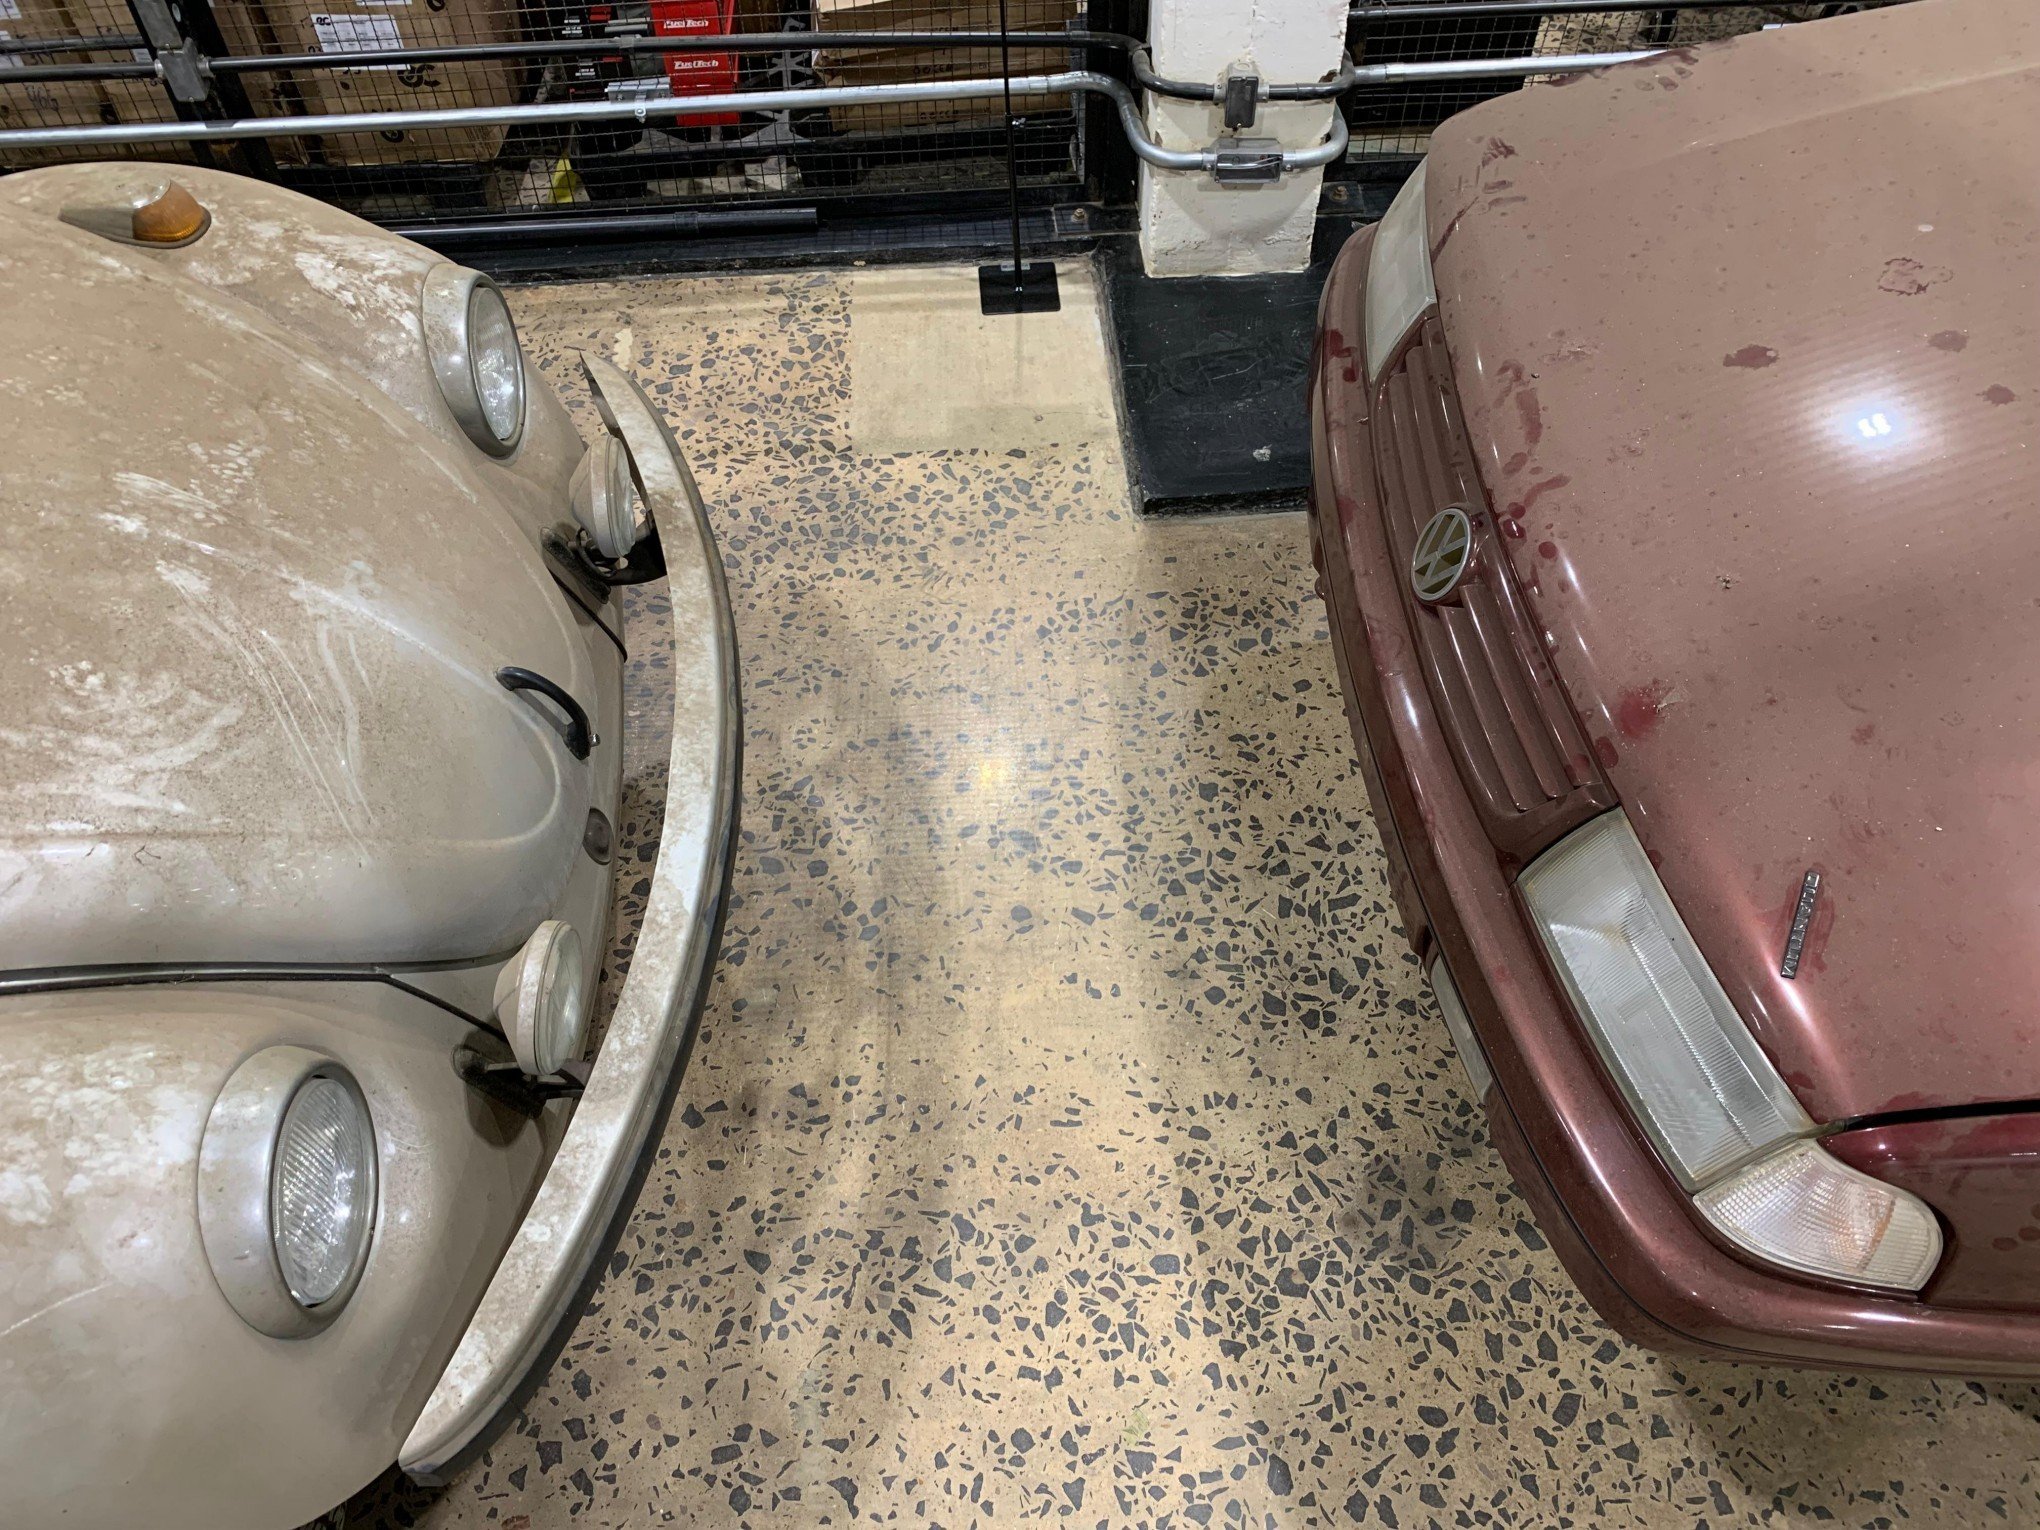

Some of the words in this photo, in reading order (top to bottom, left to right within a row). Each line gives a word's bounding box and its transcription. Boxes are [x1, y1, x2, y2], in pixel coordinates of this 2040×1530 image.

[664, 19, 709, 29] FuelTech
[674, 60, 719, 69] FuelTech
[1411, 508, 1471, 601] VW
[1782, 872, 1819, 978] QUANTUM
